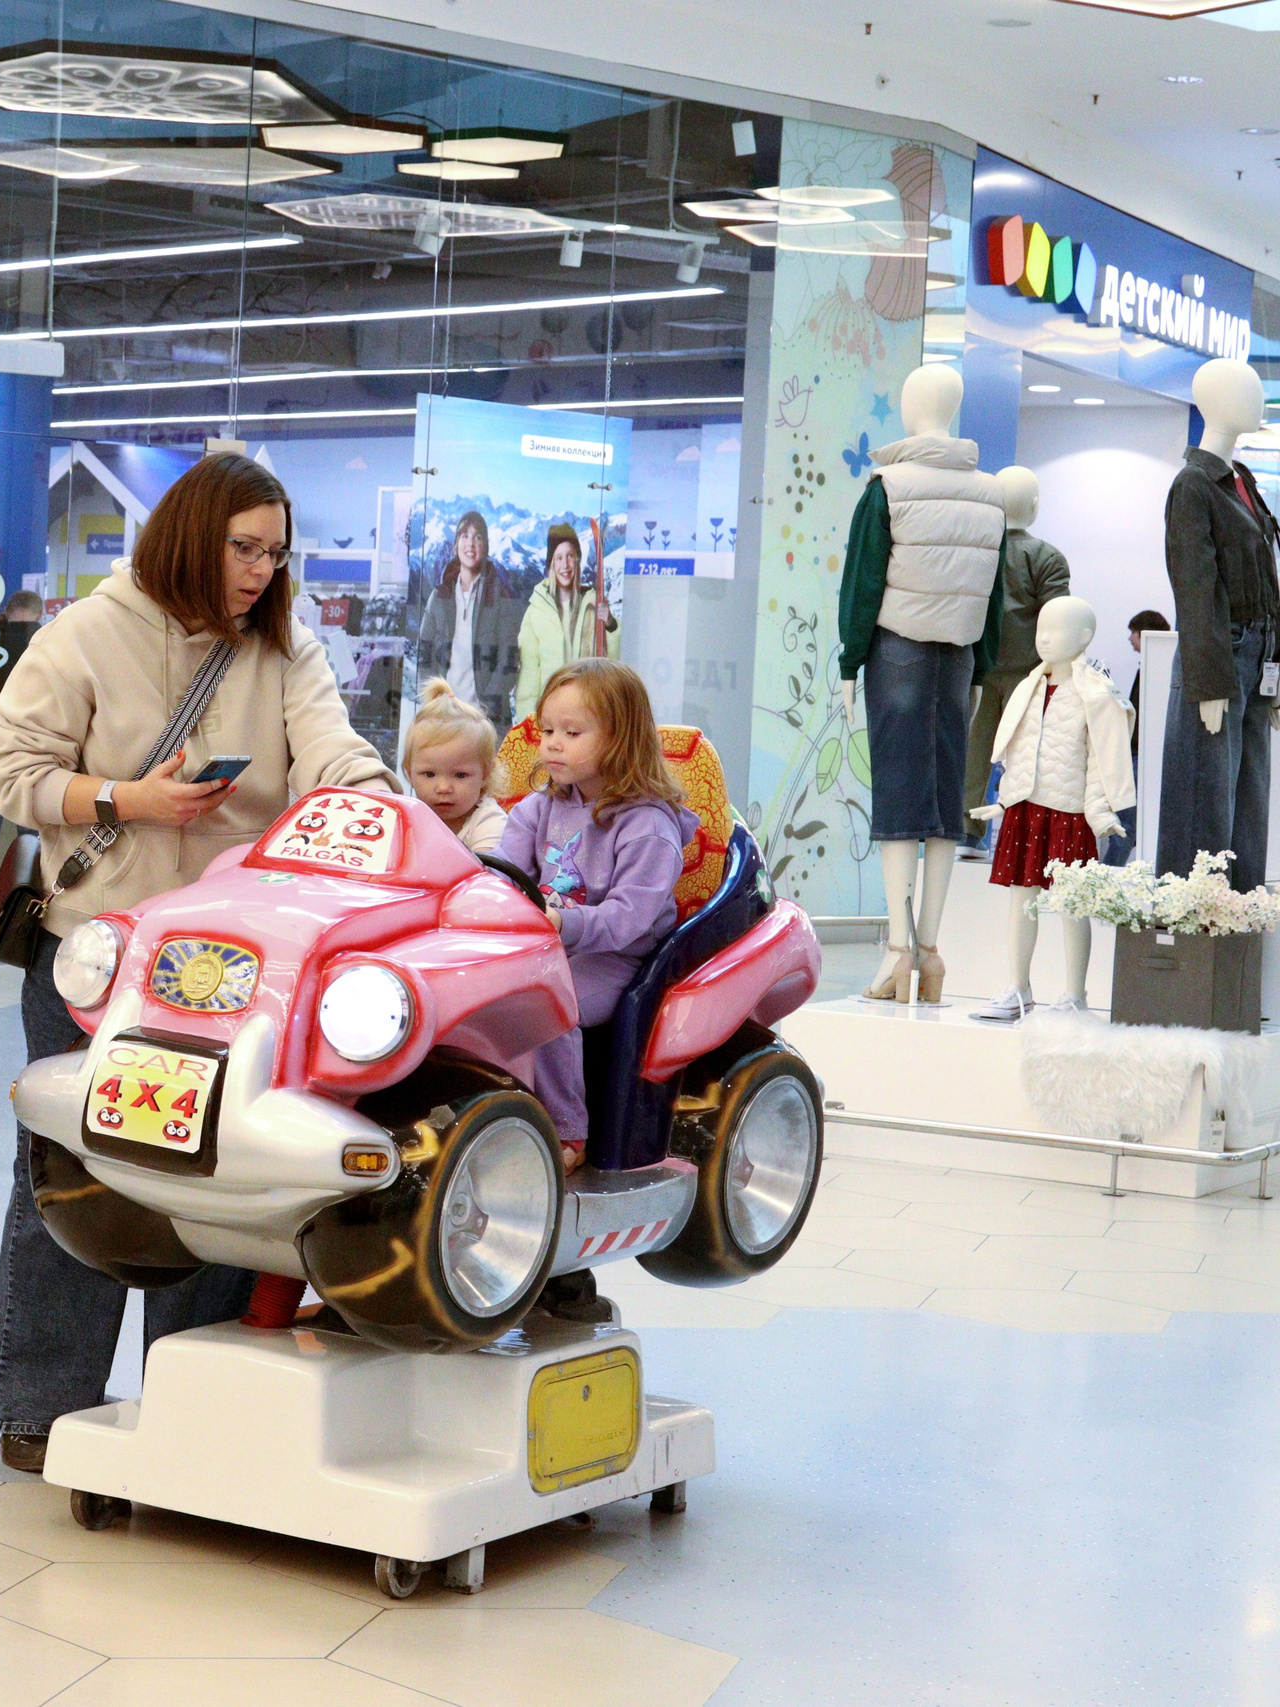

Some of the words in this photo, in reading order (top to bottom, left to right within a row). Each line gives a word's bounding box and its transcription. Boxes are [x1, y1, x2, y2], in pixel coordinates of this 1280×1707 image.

[529, 439, 561, 453] Зимняя
[639, 563, 659, 576] 7-12
[660, 567, 678, 576] лет
[107, 1047, 209, 1081] CAR
